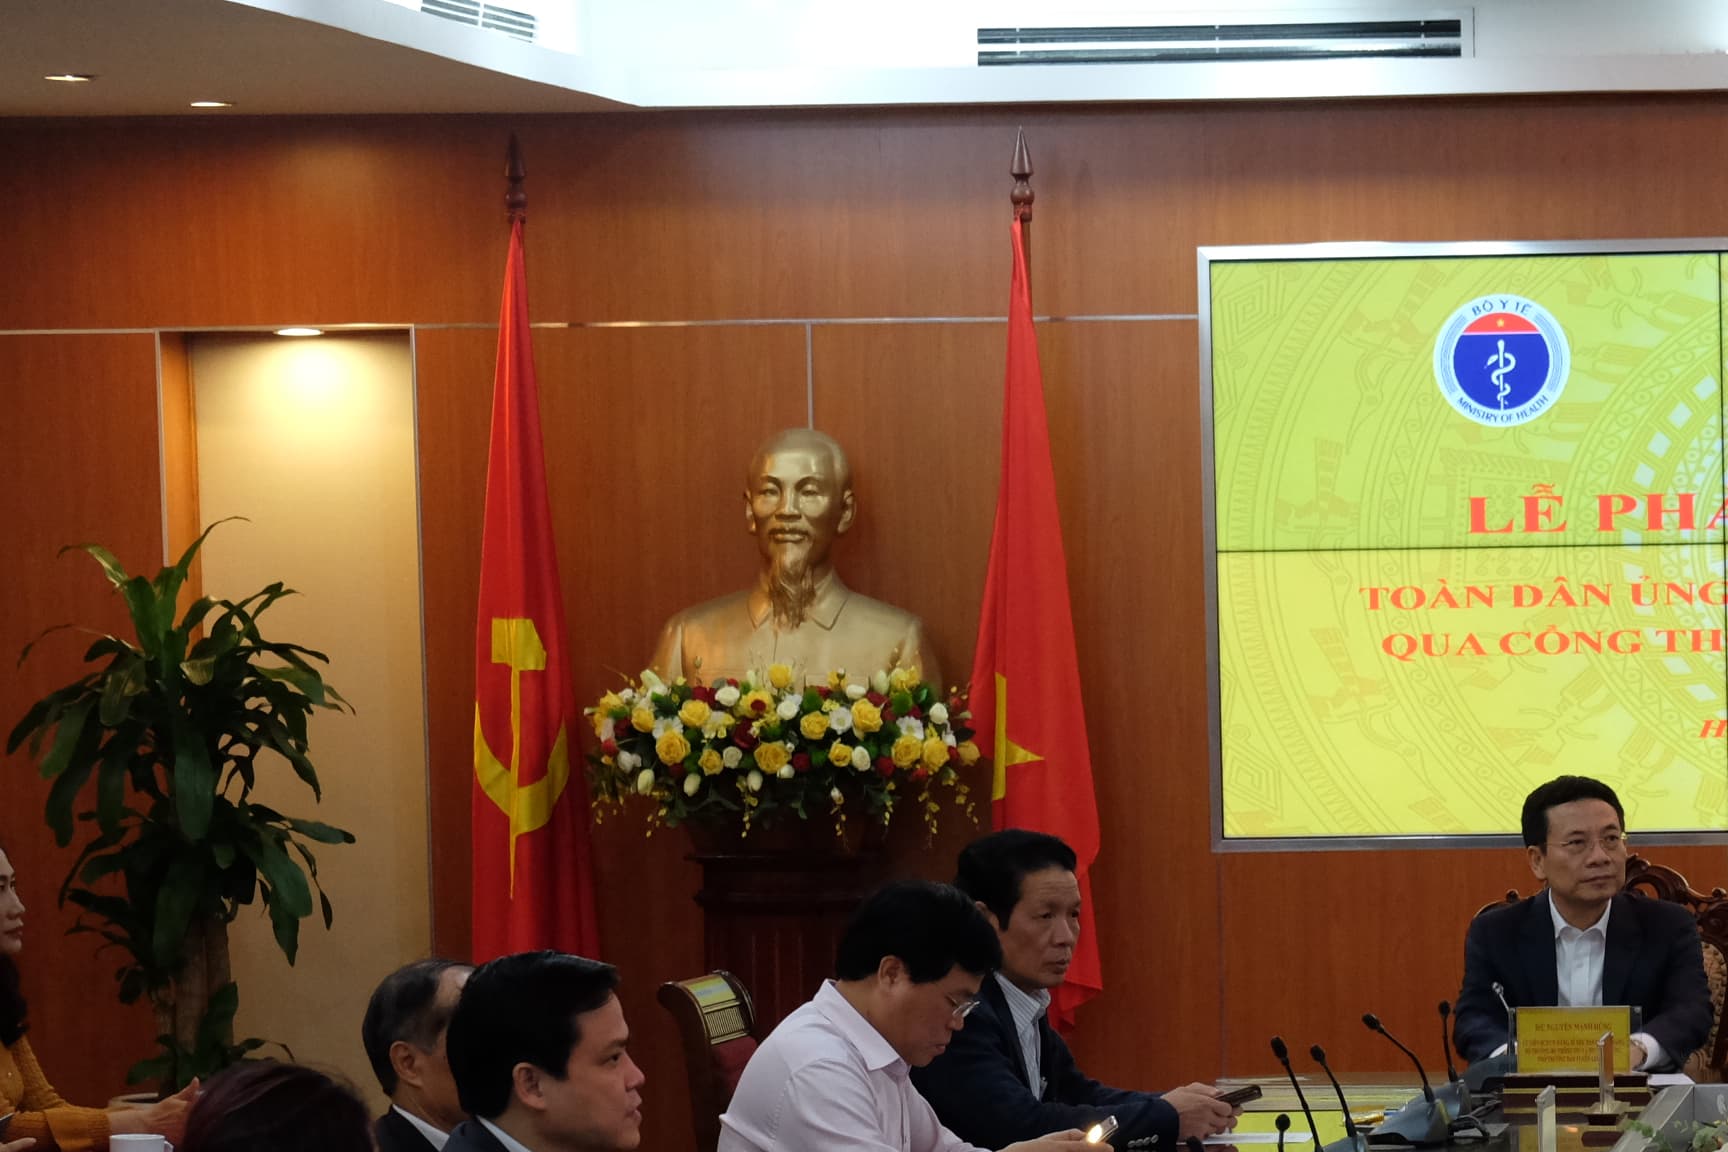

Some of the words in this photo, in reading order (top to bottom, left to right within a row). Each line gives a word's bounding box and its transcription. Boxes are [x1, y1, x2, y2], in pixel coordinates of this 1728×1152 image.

[1469, 483, 1568, 534] LỄ
[1359, 578, 1494, 611] TOÀN
[1512, 575, 1613, 608] DÂN
[1381, 632, 1487, 662] QUA
